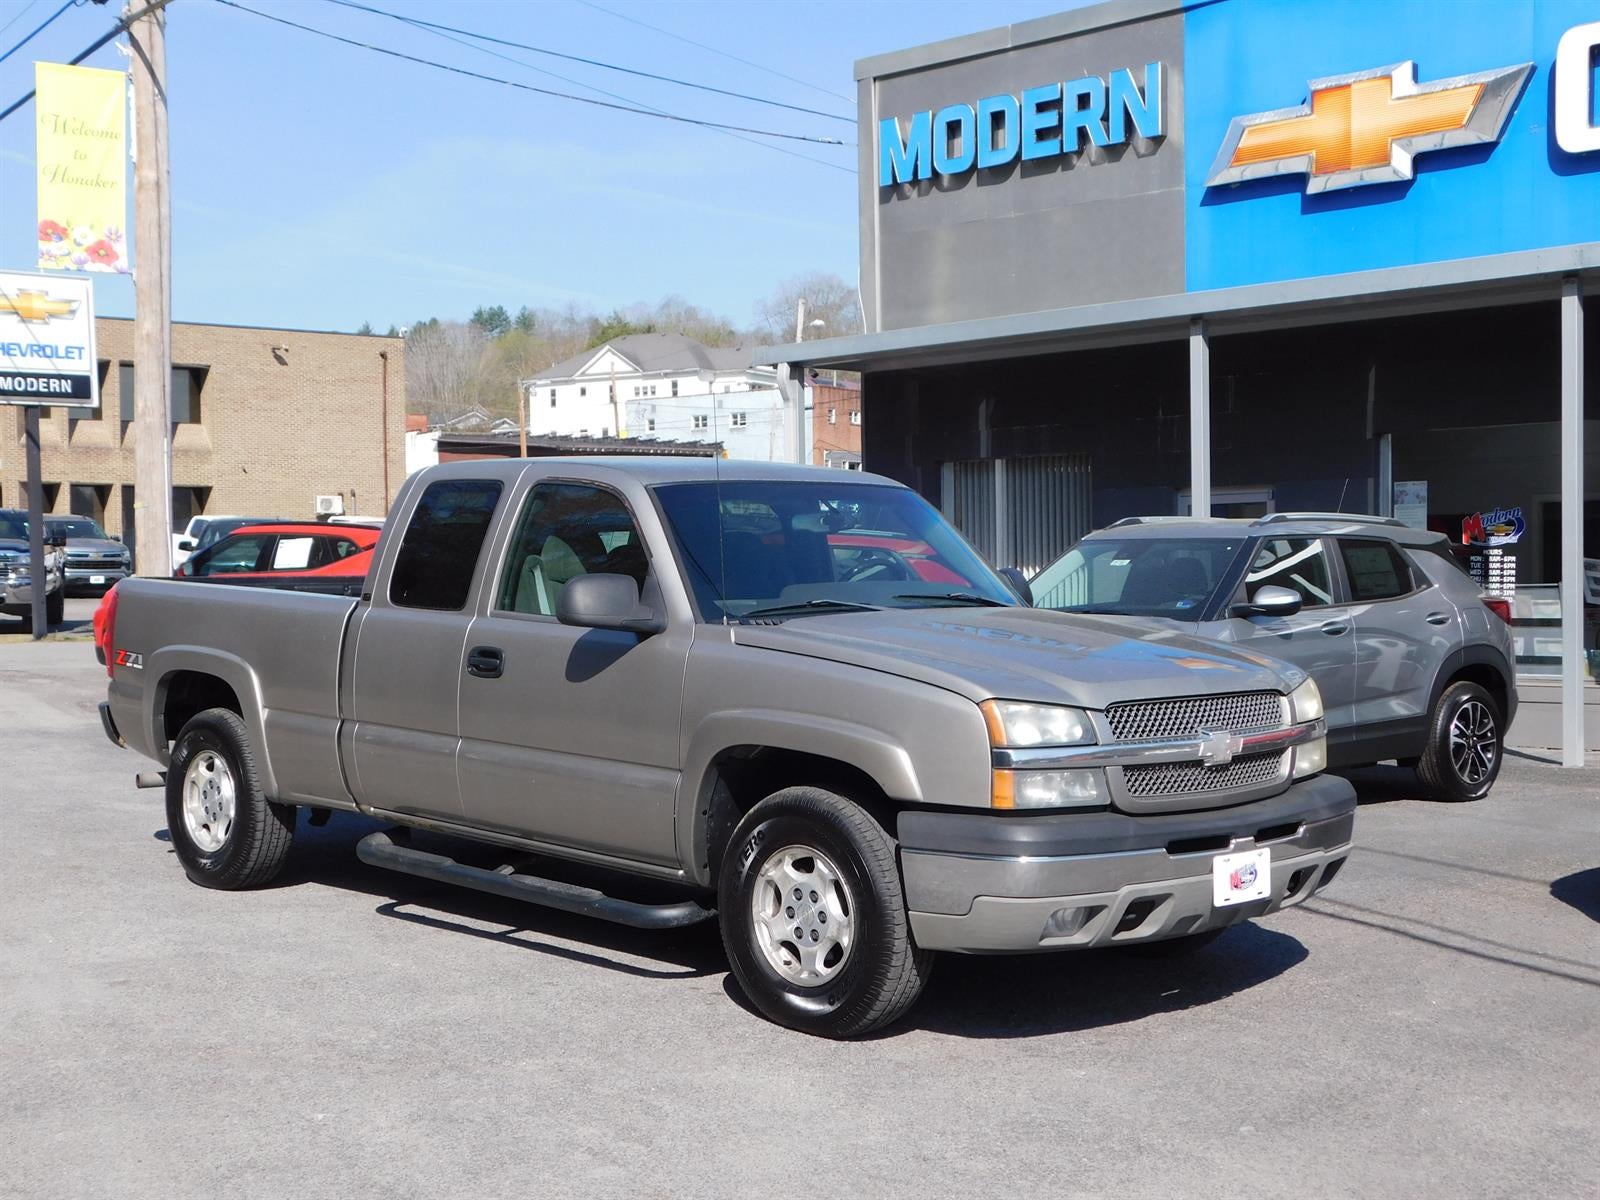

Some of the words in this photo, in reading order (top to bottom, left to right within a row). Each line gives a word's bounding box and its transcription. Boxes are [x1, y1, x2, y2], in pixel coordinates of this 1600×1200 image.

[40, 112, 122, 140] Welcome
[879, 61, 1163, 187] MODERN
[73, 149, 87, 160] to
[0, 376, 72, 393] MODERN
[1462, 507, 1521, 545] Modern
[115, 649, 143, 666] Z71
